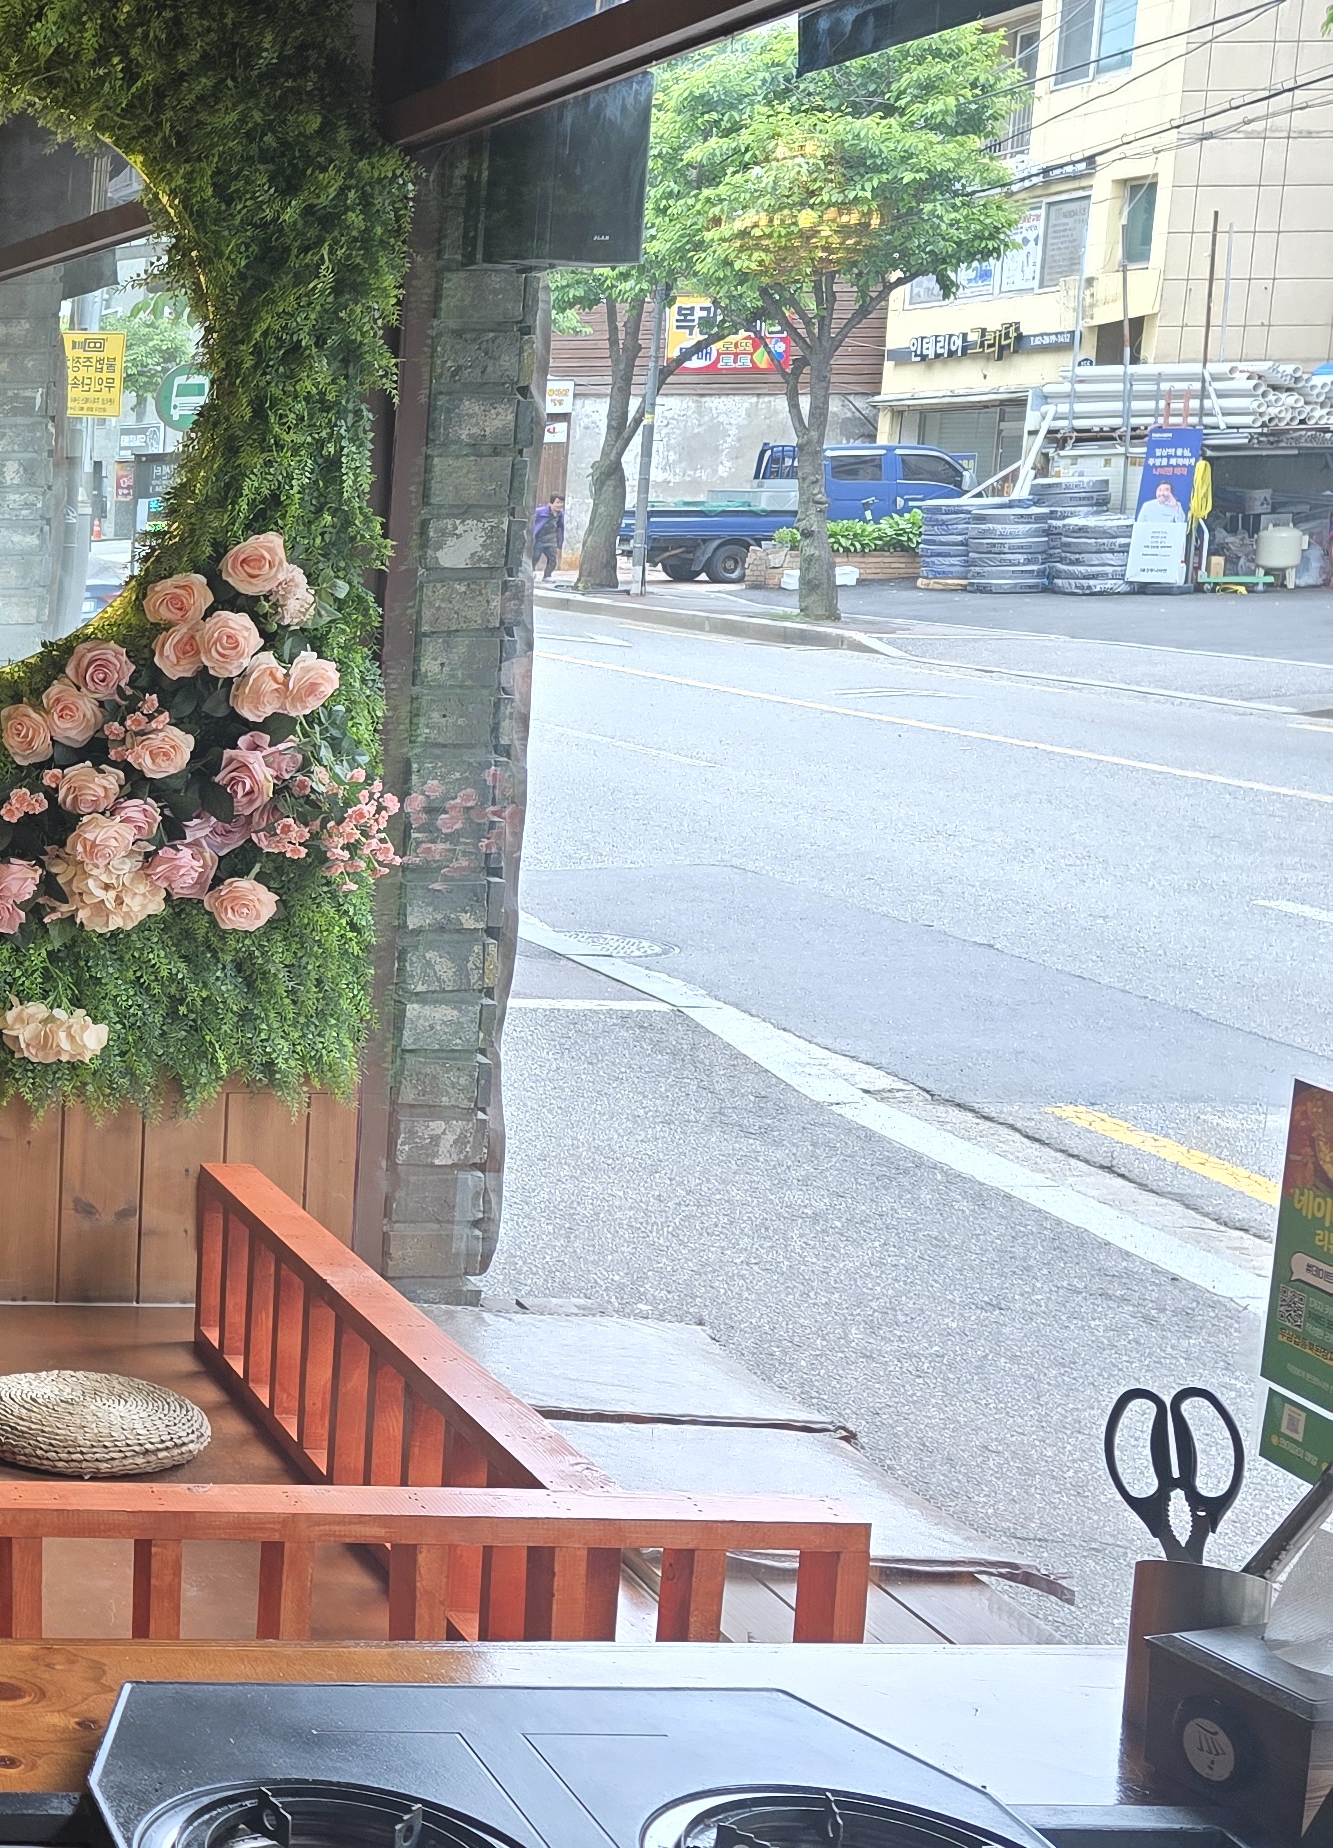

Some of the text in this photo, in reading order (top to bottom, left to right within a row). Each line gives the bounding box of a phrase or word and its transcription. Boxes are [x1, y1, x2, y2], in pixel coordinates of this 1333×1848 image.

[909, 332, 965, 362] 인테리어
[968, 321, 1022, 361] 그리다
[1293, 1188, 1333, 1228] 네이
